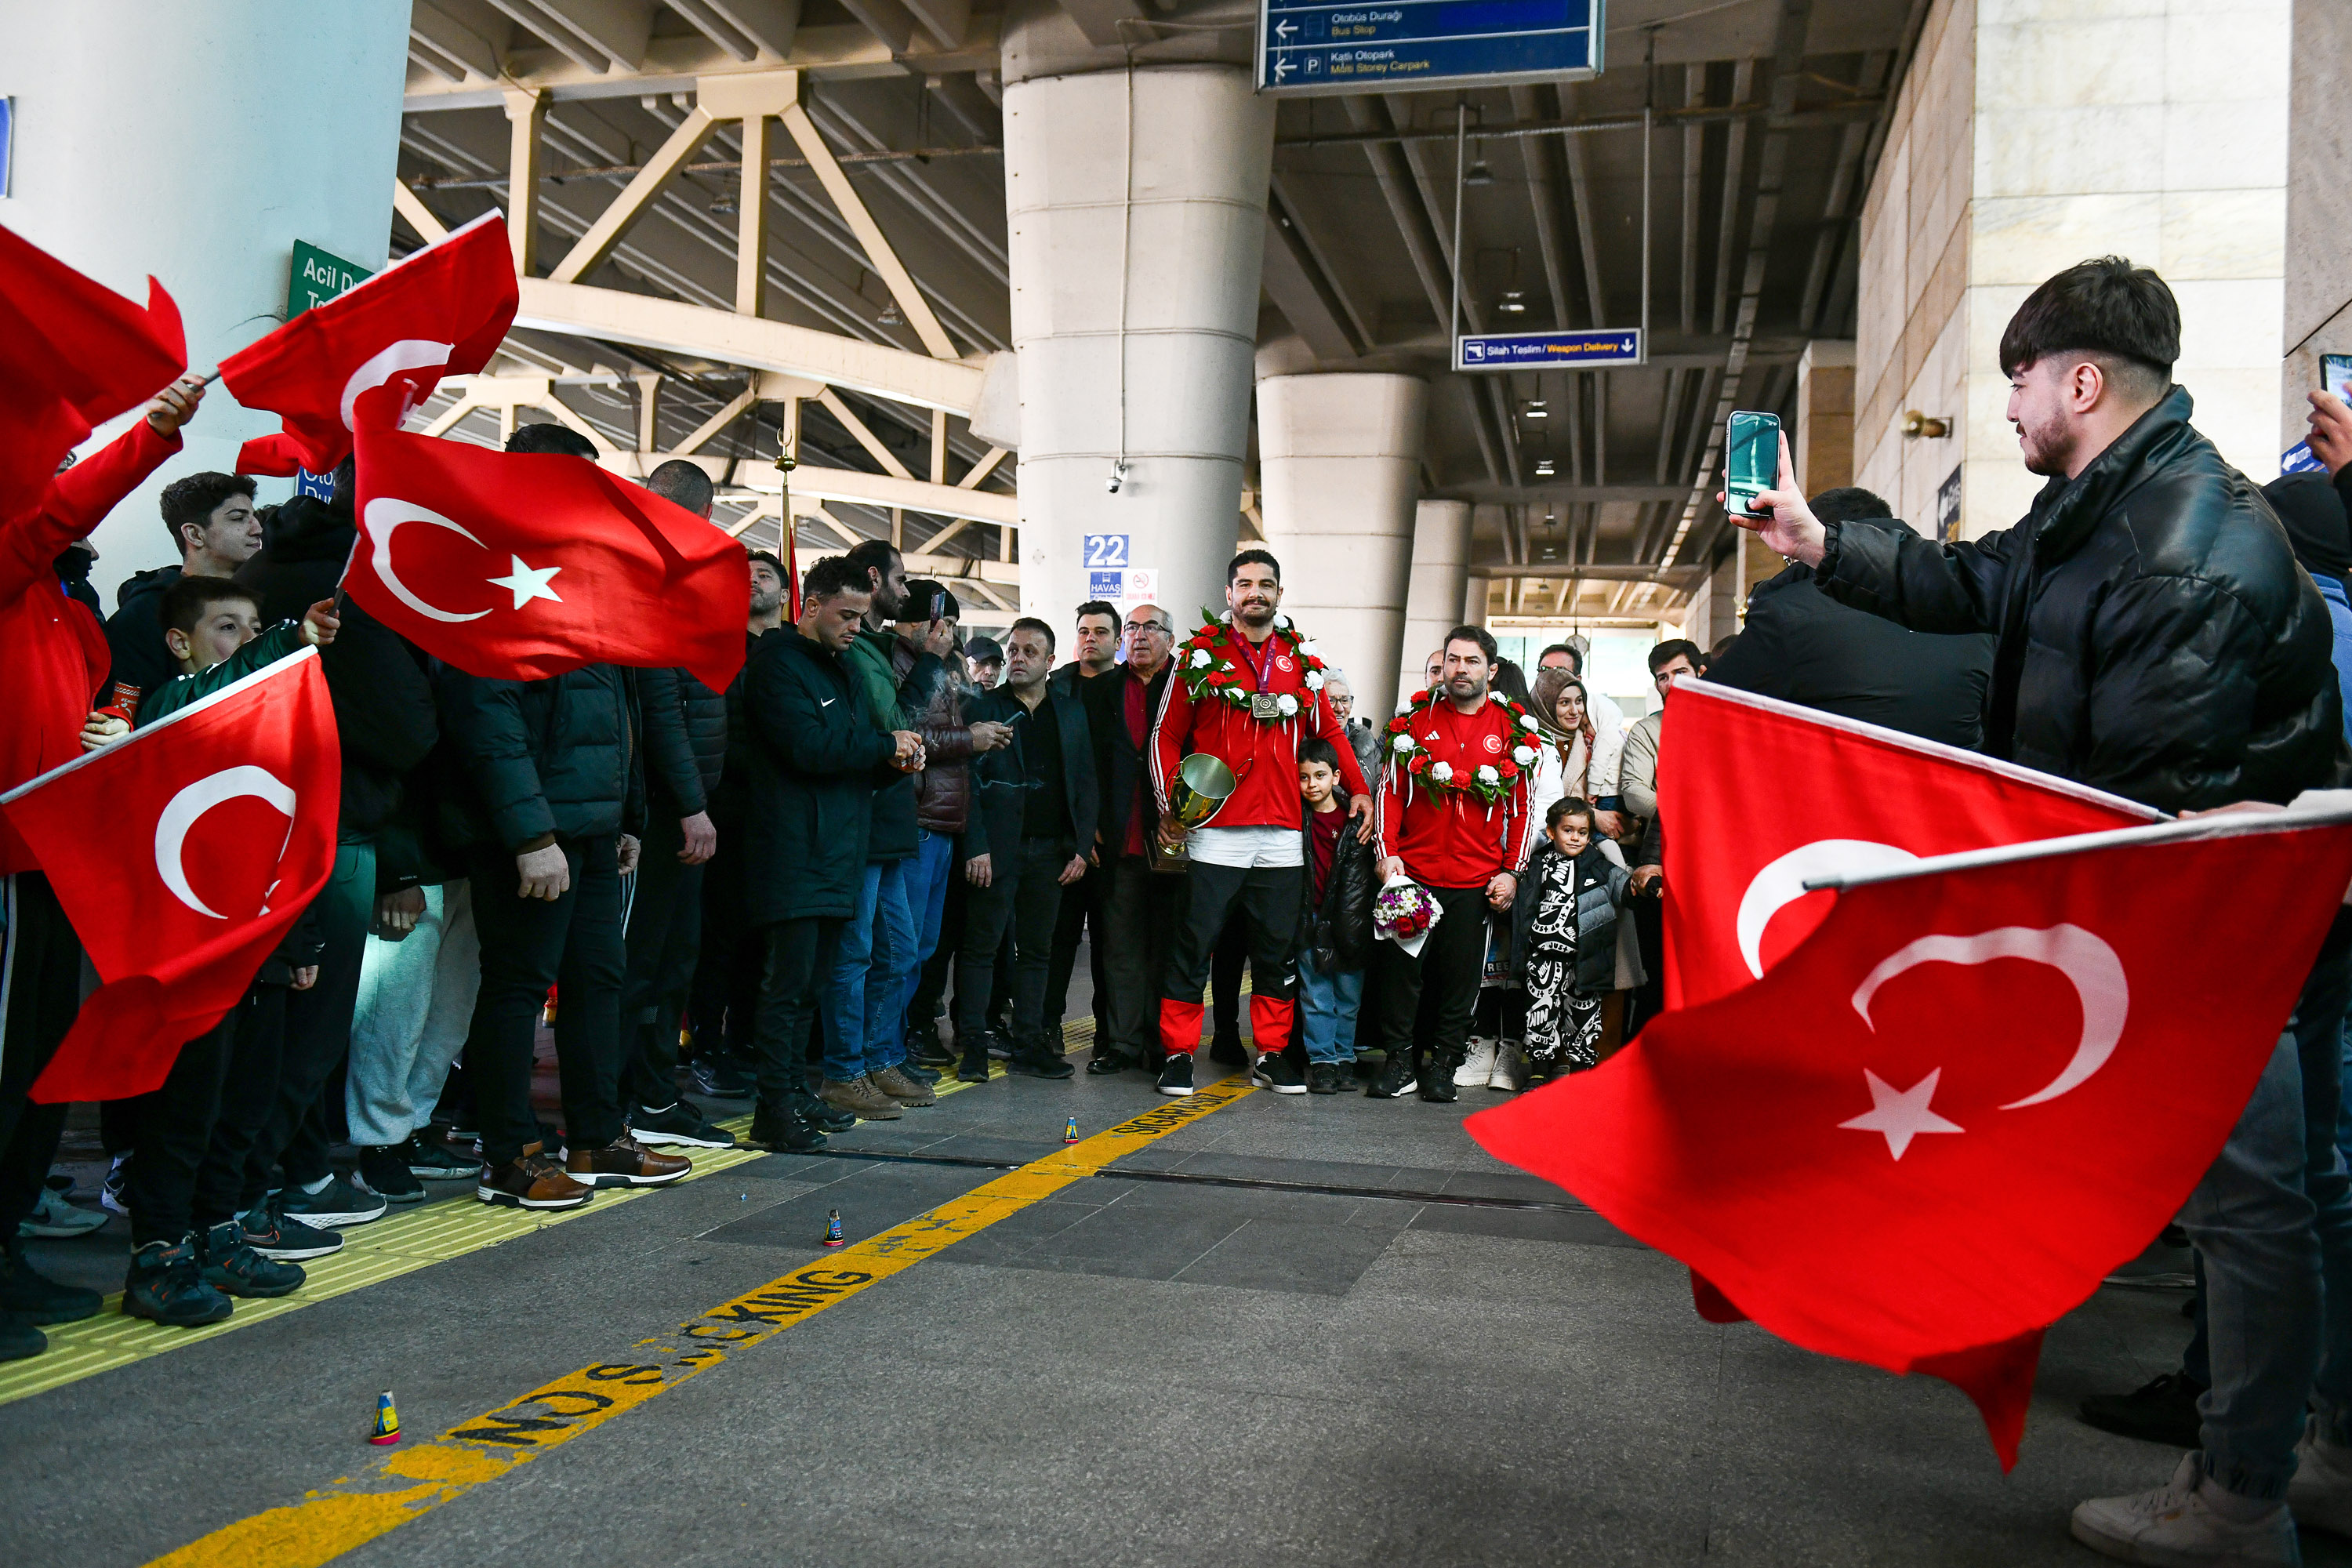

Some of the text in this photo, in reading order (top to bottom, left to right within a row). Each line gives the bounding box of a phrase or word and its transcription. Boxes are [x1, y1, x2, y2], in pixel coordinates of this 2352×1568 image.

[1370, 10, 1402, 23] Durağı
[1332, 25, 1376, 35] Bus Stop
[1356, 49, 1395, 62] Otopark
[1330, 60, 1430, 74] Multi Storey Carpark
[303, 257, 358, 292] Acil D
[1487, 346, 1510, 356] Silah
[1584, 343, 1619, 352] Delivery
[1087, 535, 1127, 565] 22
[449, 1391, 615, 1446] NO
